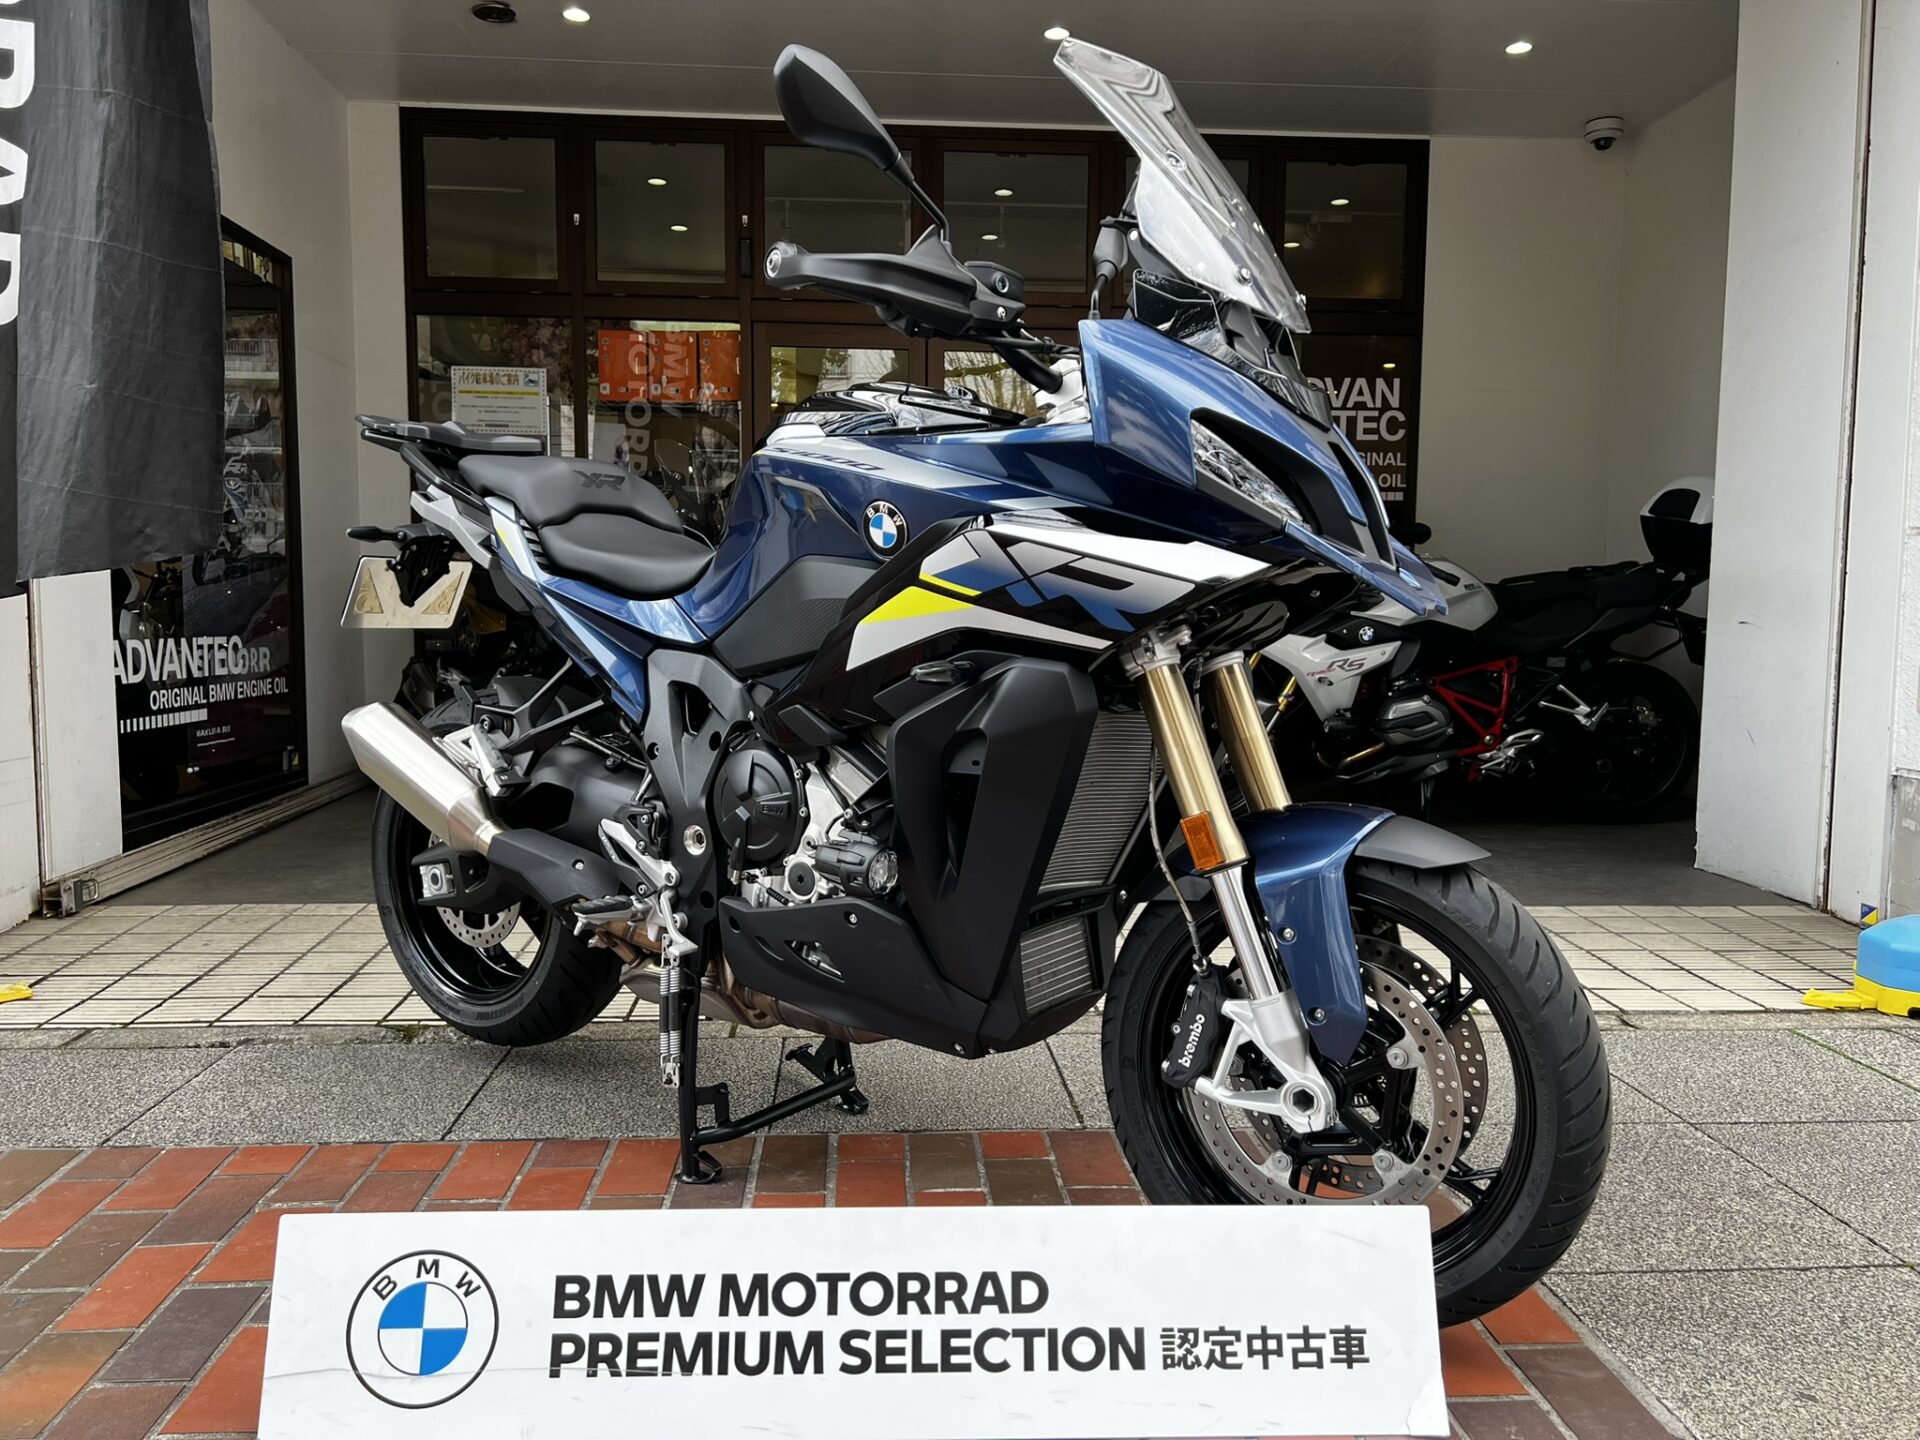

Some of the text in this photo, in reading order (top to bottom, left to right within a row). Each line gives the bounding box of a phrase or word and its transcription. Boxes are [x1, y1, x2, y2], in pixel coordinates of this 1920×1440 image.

[1330, 409, 1406, 442] TEC
[573, 470, 625, 491] XR
[1378, 473, 1407, 488] OIL
[866, 503, 903, 527] BMW
[113, 635, 243, 684] ADVANTEC
[1325, 657, 1368, 672] RS
[150, 676, 289, 711] ORIGINAL BMW ENGINE OIL
[761, 804, 785, 816] BMW
[1179, 1013, 1206, 1068] brembo
[372, 1257, 482, 1301] BMW
[552, 1270, 1050, 1319] BMW MOTORRAD
[548, 1324, 1371, 1379] PREMIUM SELECTION 認定中古車
